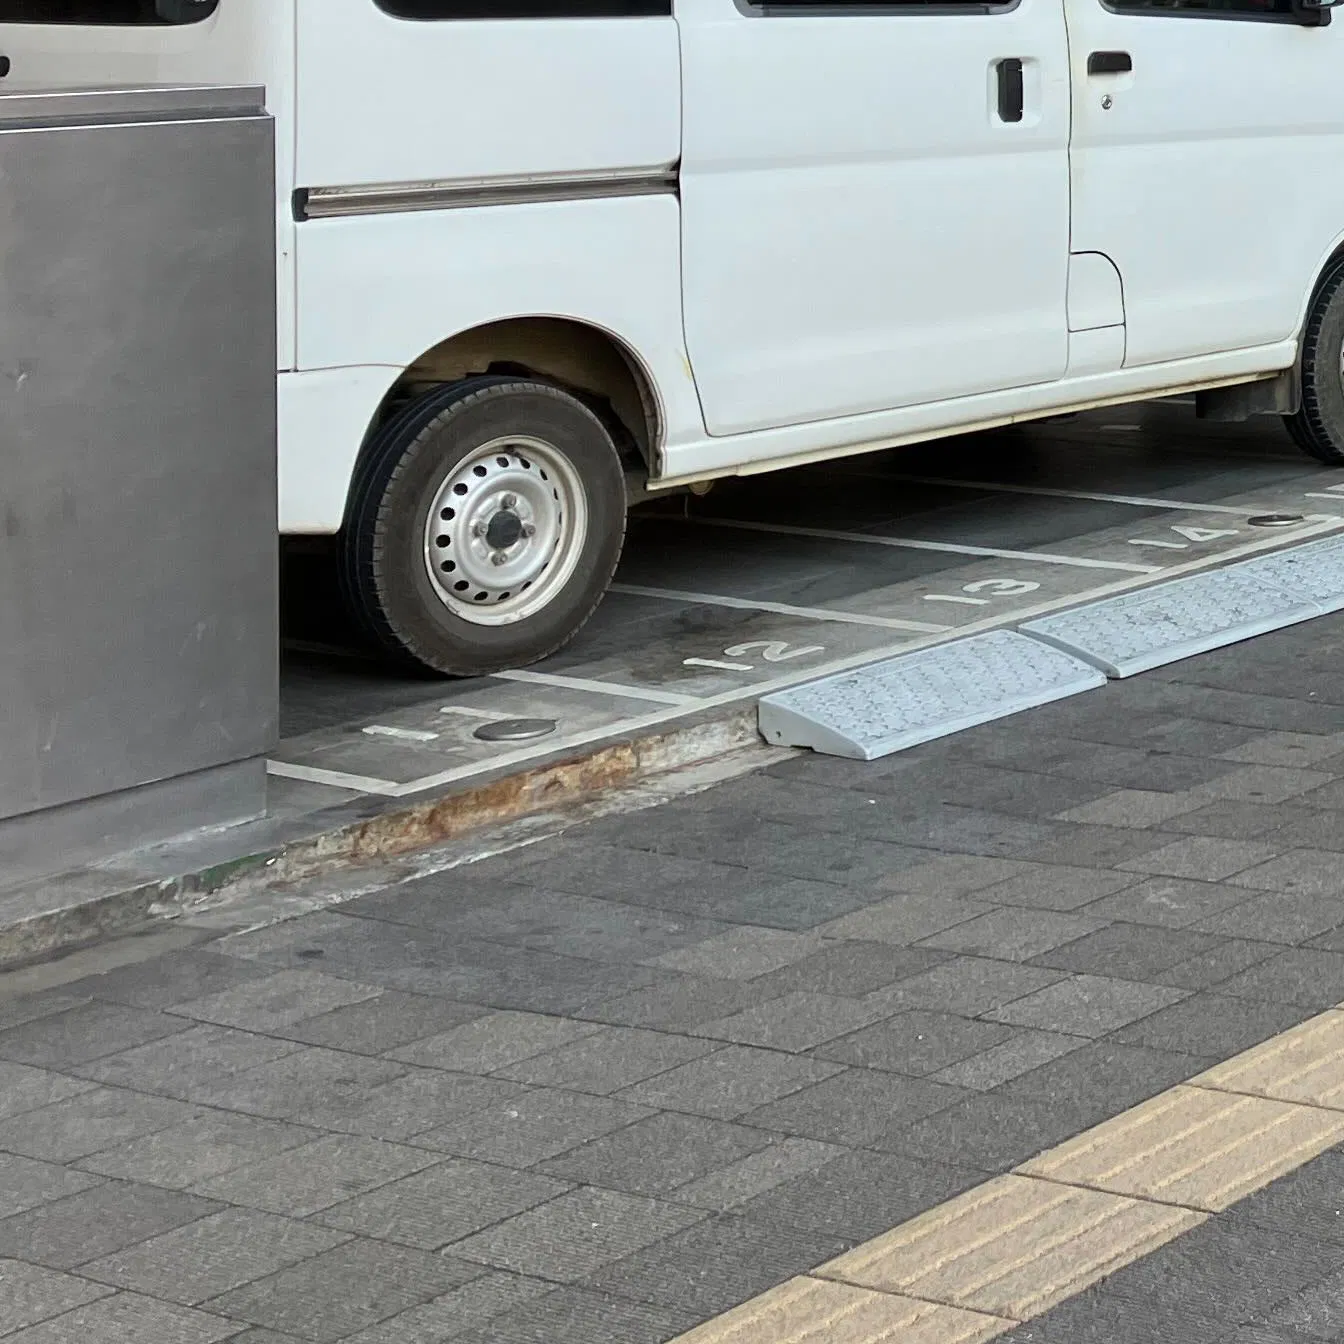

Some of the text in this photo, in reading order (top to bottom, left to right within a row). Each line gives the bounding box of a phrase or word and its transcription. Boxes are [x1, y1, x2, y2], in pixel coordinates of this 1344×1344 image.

[1127, 524, 1240, 549] 14
[921, 577, 1042, 606] 13
[682, 640, 826, 671] 12
